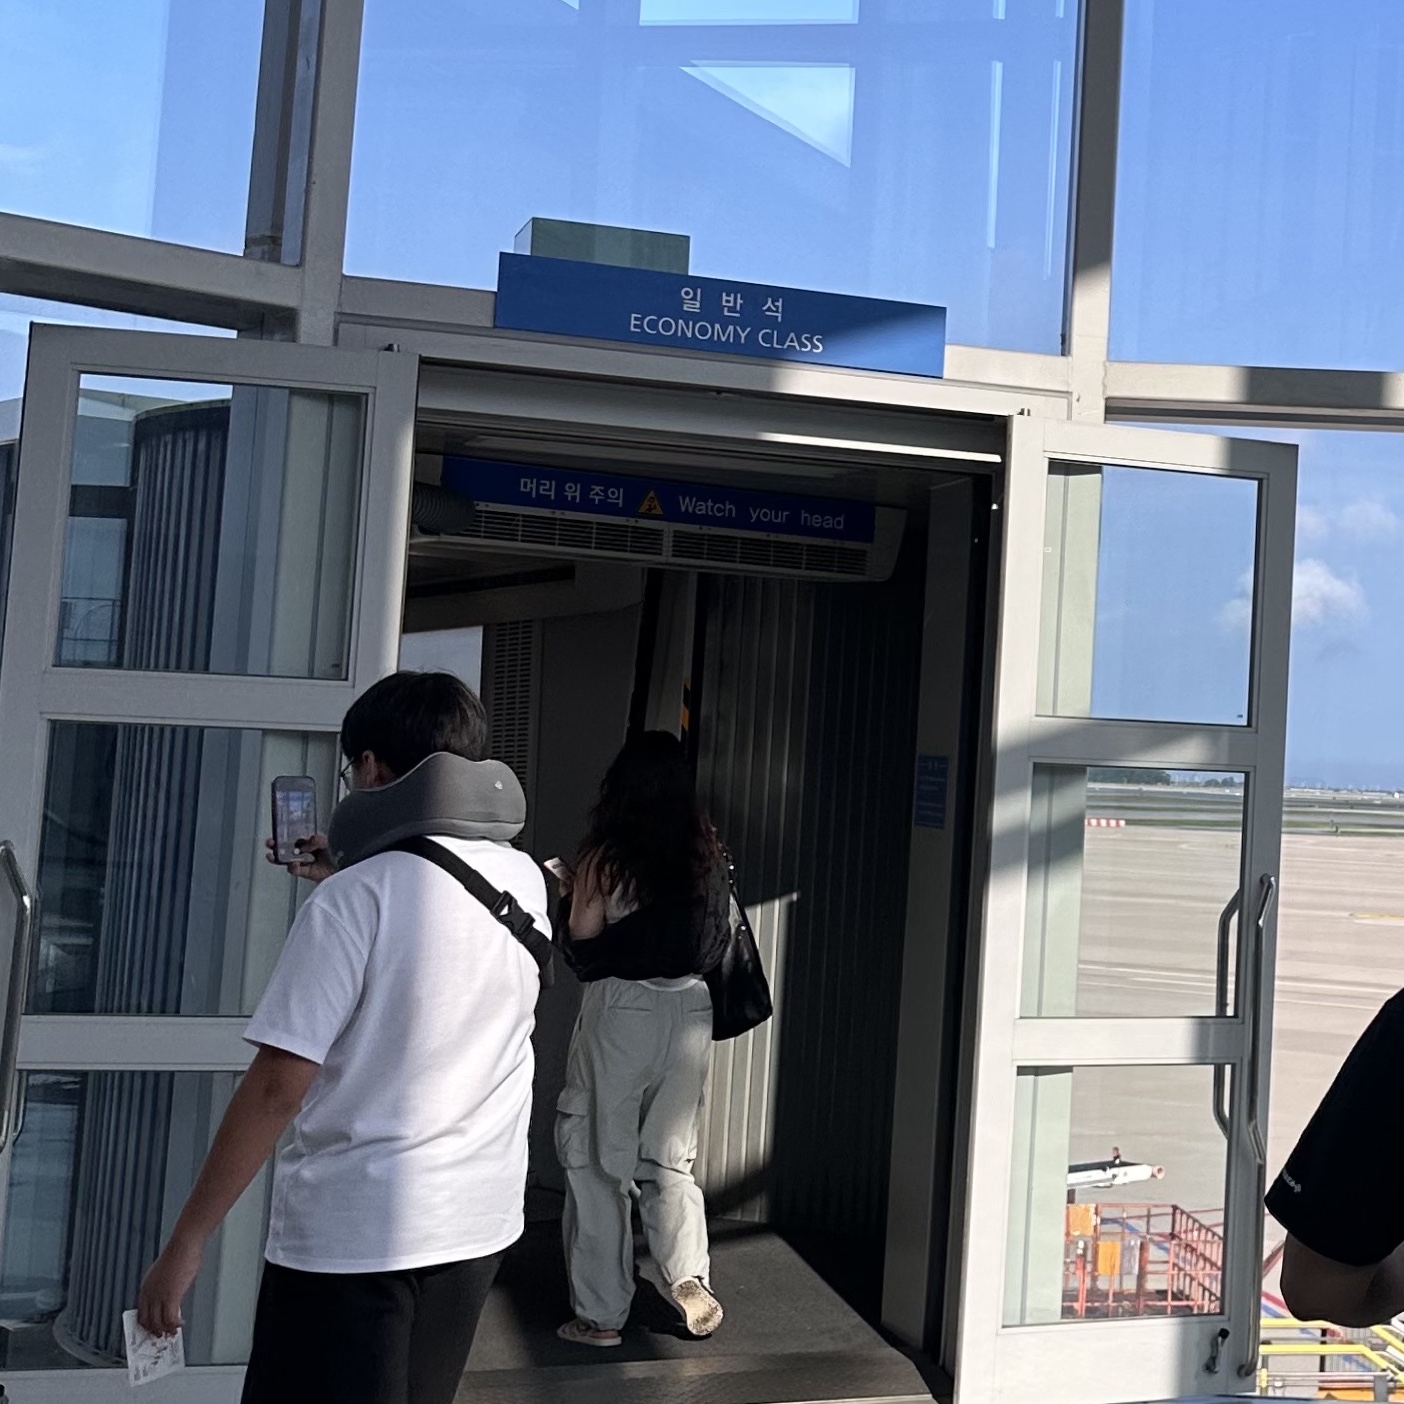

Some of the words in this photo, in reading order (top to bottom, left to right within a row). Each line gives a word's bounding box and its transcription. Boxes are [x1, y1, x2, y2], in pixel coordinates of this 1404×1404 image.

[629, 313, 750, 345] ECONOMY
[758, 328, 824, 353] CLASS
[519, 476, 556, 501] 머리
[563, 480, 582, 503] 위
[588, 484, 625, 509] 주의
[678, 494, 737, 519] Watch
[749, 507, 790, 526] your
[800, 507, 845, 531] head
